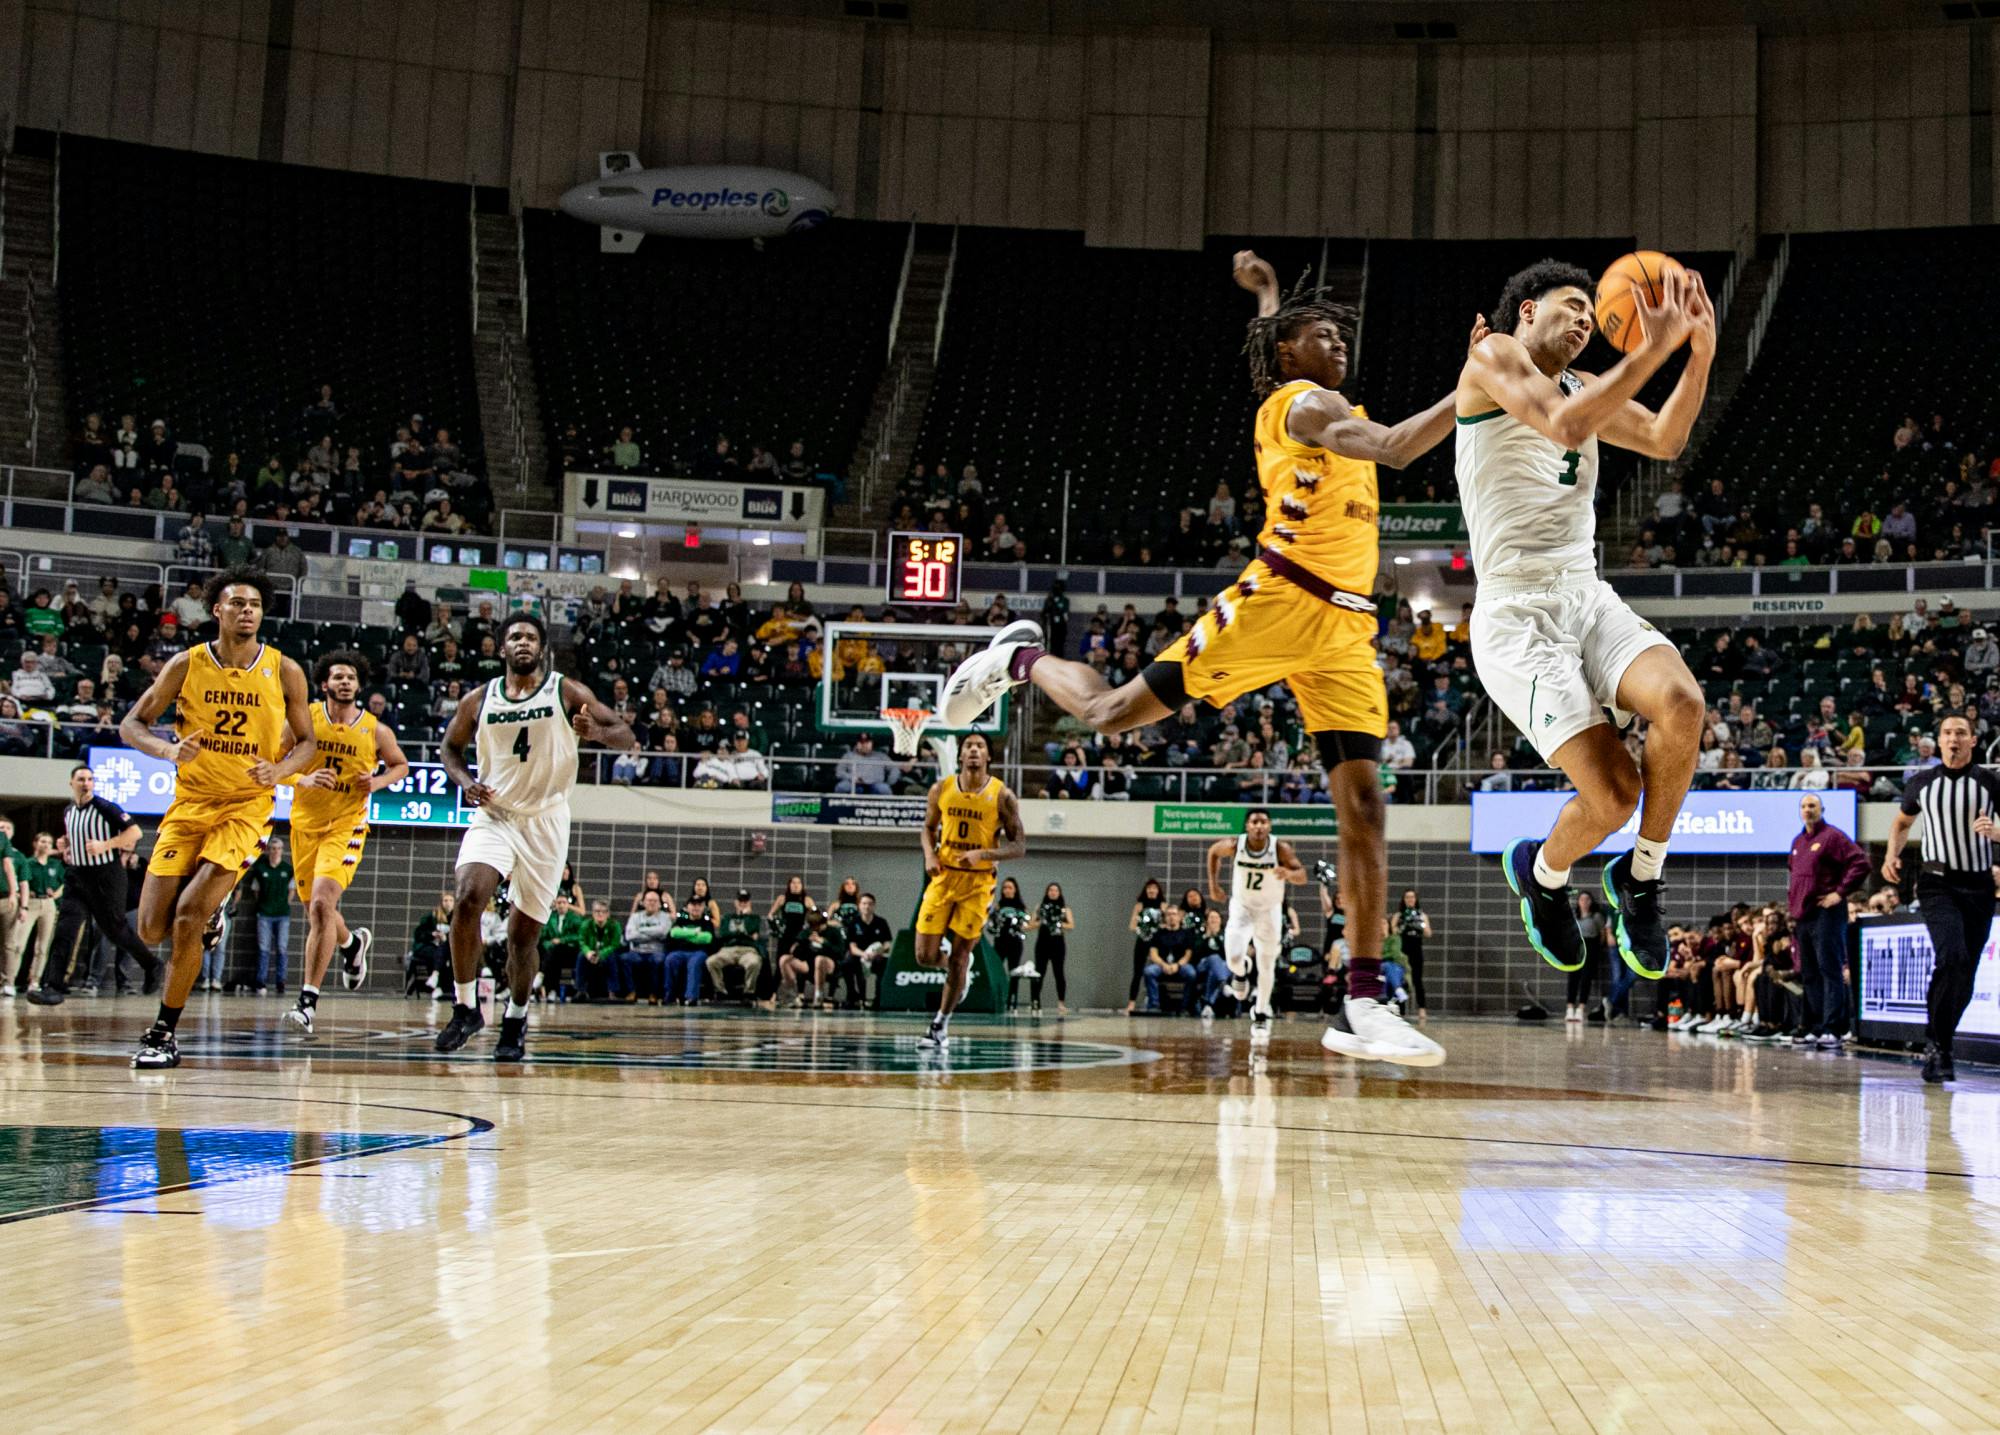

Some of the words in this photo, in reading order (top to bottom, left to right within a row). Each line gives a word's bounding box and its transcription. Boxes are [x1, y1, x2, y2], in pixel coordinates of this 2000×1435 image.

[651, 188, 757, 211] Peoples
[652, 490, 739, 507] HARDWOOD
[1376, 515, 1447, 532] Holzer
[909, 539, 956, 563] 5:12
[903, 562, 947, 599] 30
[1753, 600, 1824, 612] RESERVED
[204, 690, 261, 707] CENTRAL
[214, 710, 248, 736] 22
[487, 706, 555, 724] BOBCATS
[199, 737, 258, 757] MICHIGAN
[316, 739, 358, 757] CENTRAL
[513, 726, 531, 763] 4
[324, 756, 344, 777] 15
[401, 801, 432, 820] :30
[947, 806, 983, 821] CENTRAL
[1162, 809, 1223, 823] Networking
[959, 821, 969, 840] 0
[1183, 821, 1200, 831] got
[1246, 872, 1264, 890] 12
